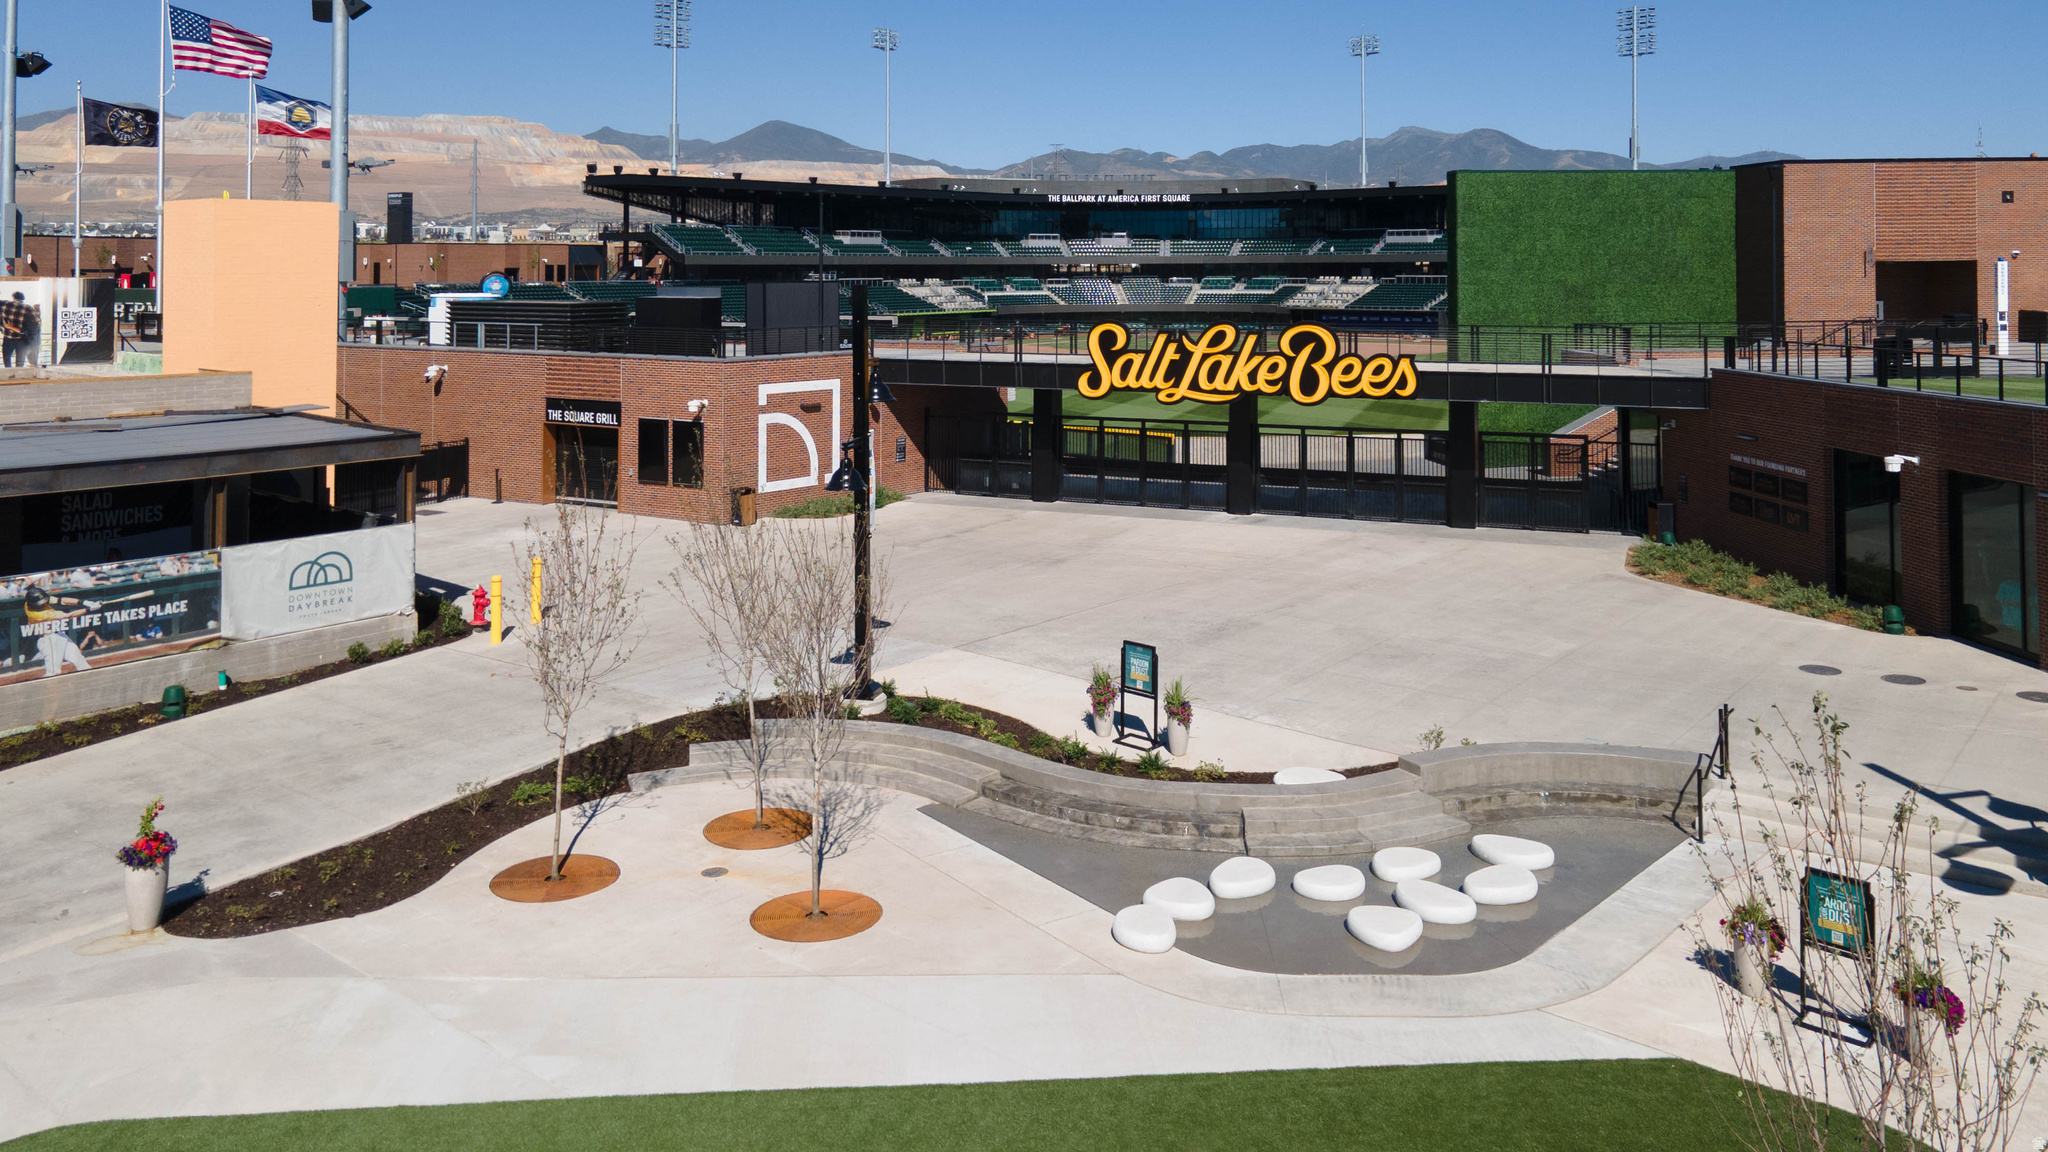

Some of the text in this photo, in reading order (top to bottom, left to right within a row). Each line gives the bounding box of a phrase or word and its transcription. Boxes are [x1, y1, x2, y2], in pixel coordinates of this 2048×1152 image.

[1047, 194, 1190, 203] THE BALLPARK AT AMERICA FIRST SQUARE
[1078, 322, 1417, 404] Salt Lake Bees
[547, 409, 618, 425] THE SQUARE GRILL
[61, 491, 113, 513] SALAD
[61, 504, 164, 532] SANDWICHES
[288, 586, 353, 603] DOWNTOWN
[288, 595, 353, 613] DAYBREAK
[20, 600, 188, 638] WHERE LIFE TAKES PLACE
